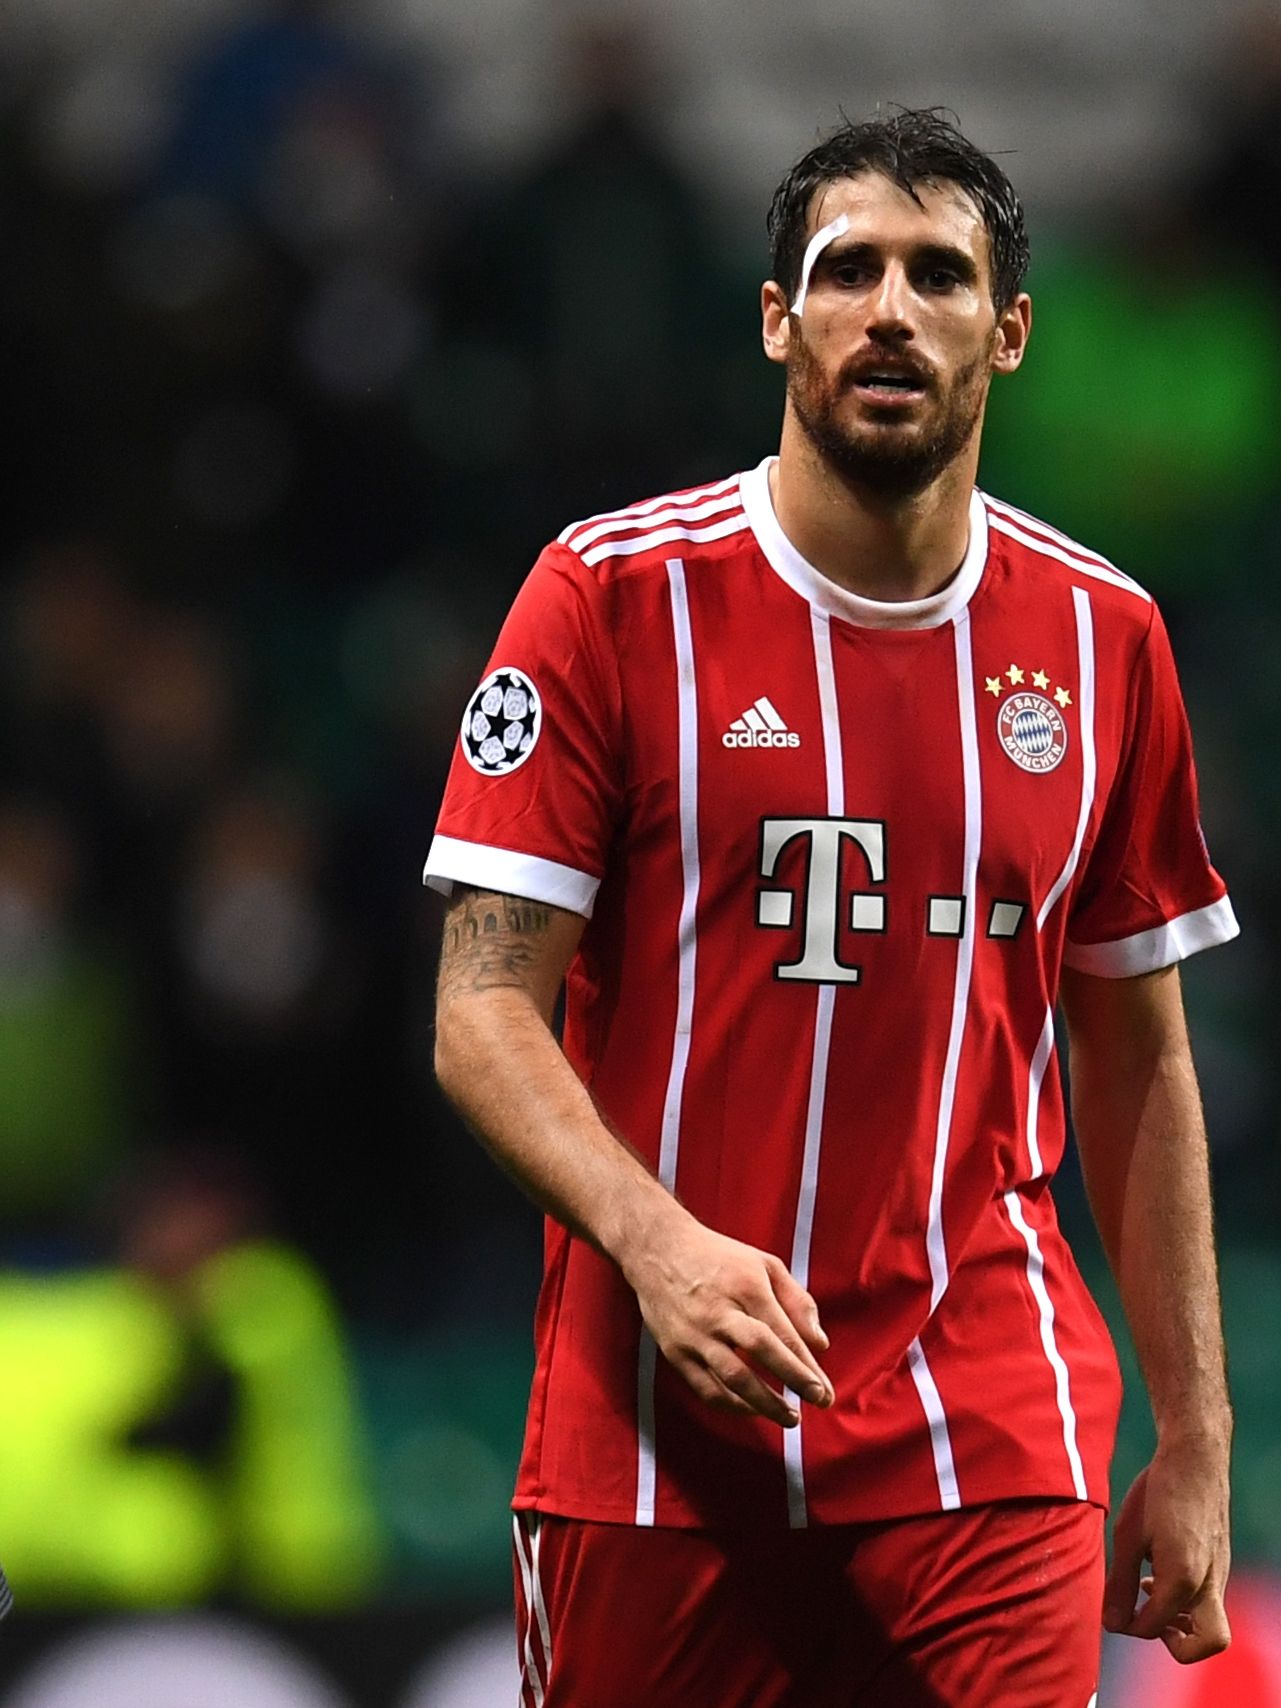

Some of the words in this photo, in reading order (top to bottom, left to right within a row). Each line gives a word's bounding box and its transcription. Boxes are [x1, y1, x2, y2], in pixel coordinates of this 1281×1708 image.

[1002, 706, 1015, 725] FC
[1014, 697, 1061, 731] BAYERN
[722, 730, 800, 748] adidas
